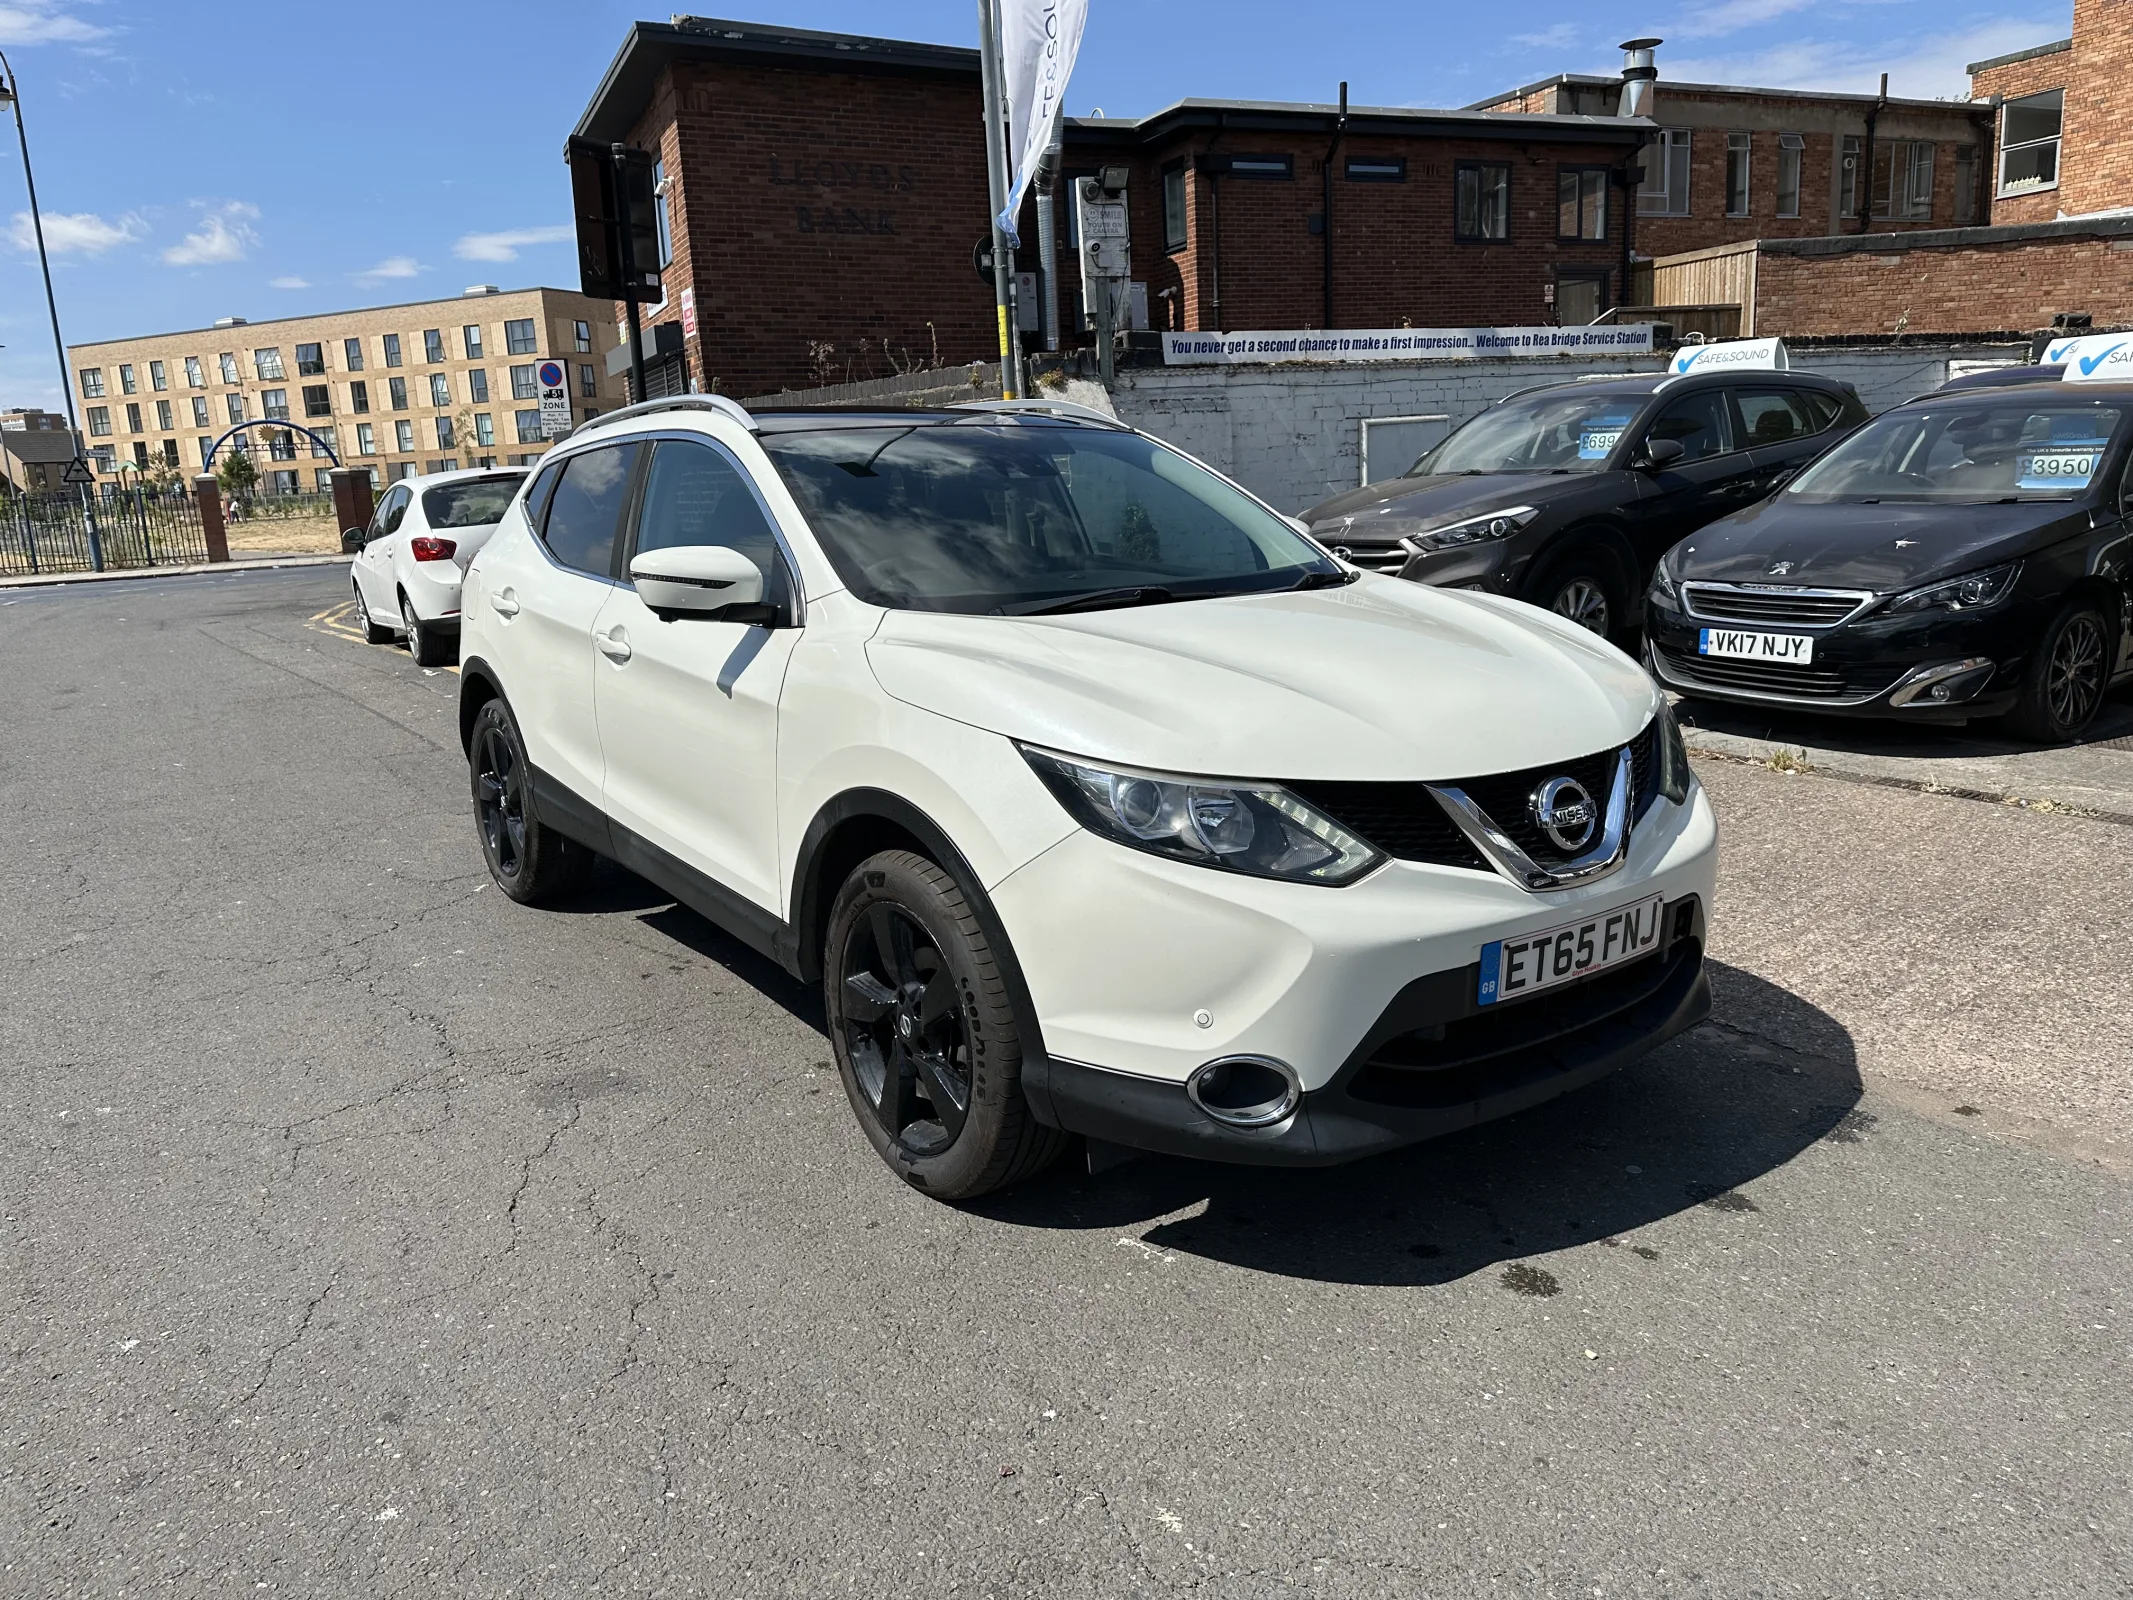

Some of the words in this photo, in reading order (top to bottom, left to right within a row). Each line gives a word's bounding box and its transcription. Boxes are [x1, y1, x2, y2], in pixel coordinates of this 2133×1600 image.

[795, 205, 900, 235] BANK
[1100, 210, 1122, 219] SMILE
[1171, 339, 1192, 353] You
[1194, 341, 1226, 353] never
[1228, 339, 1246, 355] get
[1248, 341, 1255, 352] a
[1257, 338, 1297, 352] second
[1298, 338, 1337, 351] chance
[1339, 338, 1350, 350] to
[1352, 337, 1380, 350] make
[1382, 339, 1389, 349] a
[1391, 336, 1413, 349] first
[1476, 334, 1520, 347] Welcome
[1521, 334, 1531, 346] to
[1533, 334, 1549, 346] Rea
[1551, 333, 1581, 347] Bridge
[1582, 332, 1615, 345] Service
[1616, 331, 1647, 344] Station
[1697, 348, 1769, 364] SAFE&SOUND
[2020, 458, 2090, 476] £3950
[1716, 631, 1757, 654] VK17
[1762, 635, 1804, 658] NJY
[1551, 802, 1596, 825] NISSAN
[1504, 922, 1596, 991] ET65
[1602, 901, 1658, 961] FNJ
[1481, 980, 1496, 995] GB
